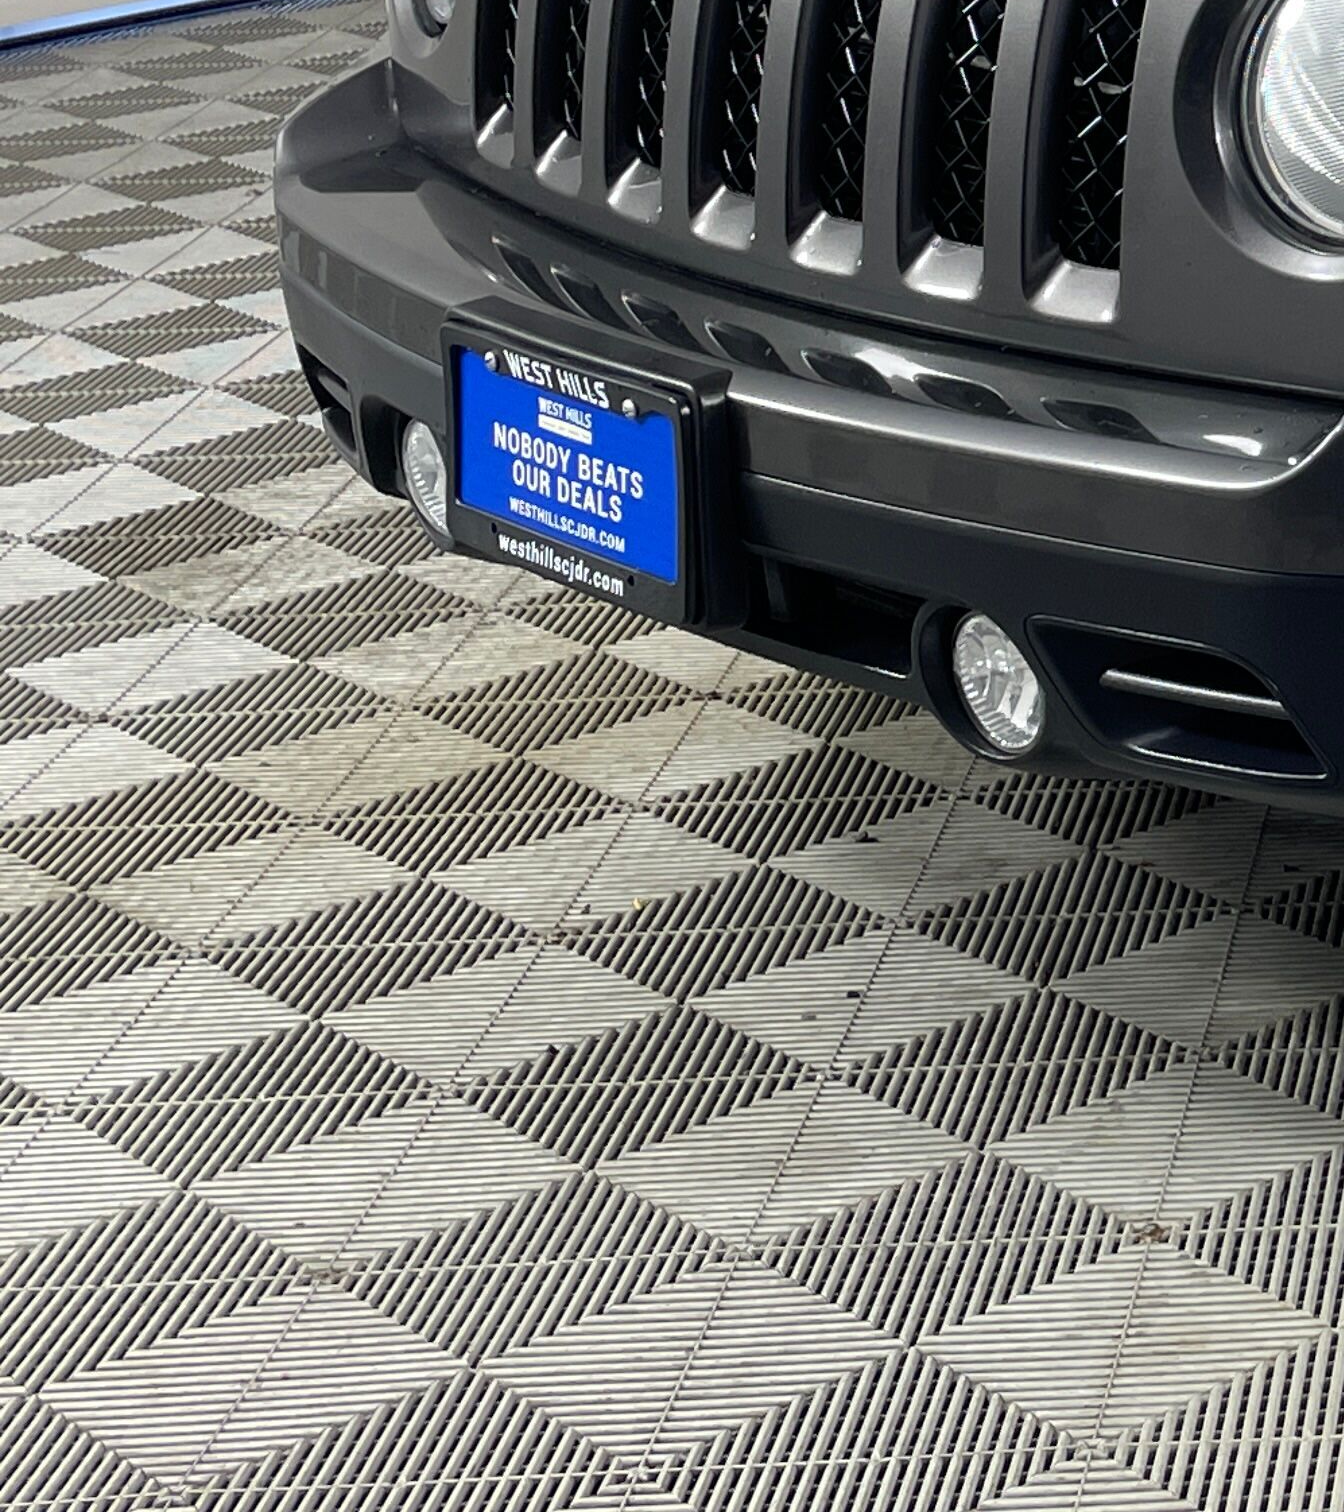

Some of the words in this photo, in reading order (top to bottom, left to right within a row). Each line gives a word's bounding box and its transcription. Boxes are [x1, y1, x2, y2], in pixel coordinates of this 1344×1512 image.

[502, 349, 553, 389] WEST
[556, 368, 610, 409] HILLS
[538, 396, 564, 418] WEST
[565, 406, 592, 430] HILLS
[493, 422, 571, 474] NOBODY
[577, 452, 643, 500] BEATS
[512, 459, 551, 498] OUR
[557, 477, 623, 523] DEALS
[508, 496, 626, 554] WESTHILLSCJDR.COM
[498, 533, 625, 597] westhillscjdr.com
